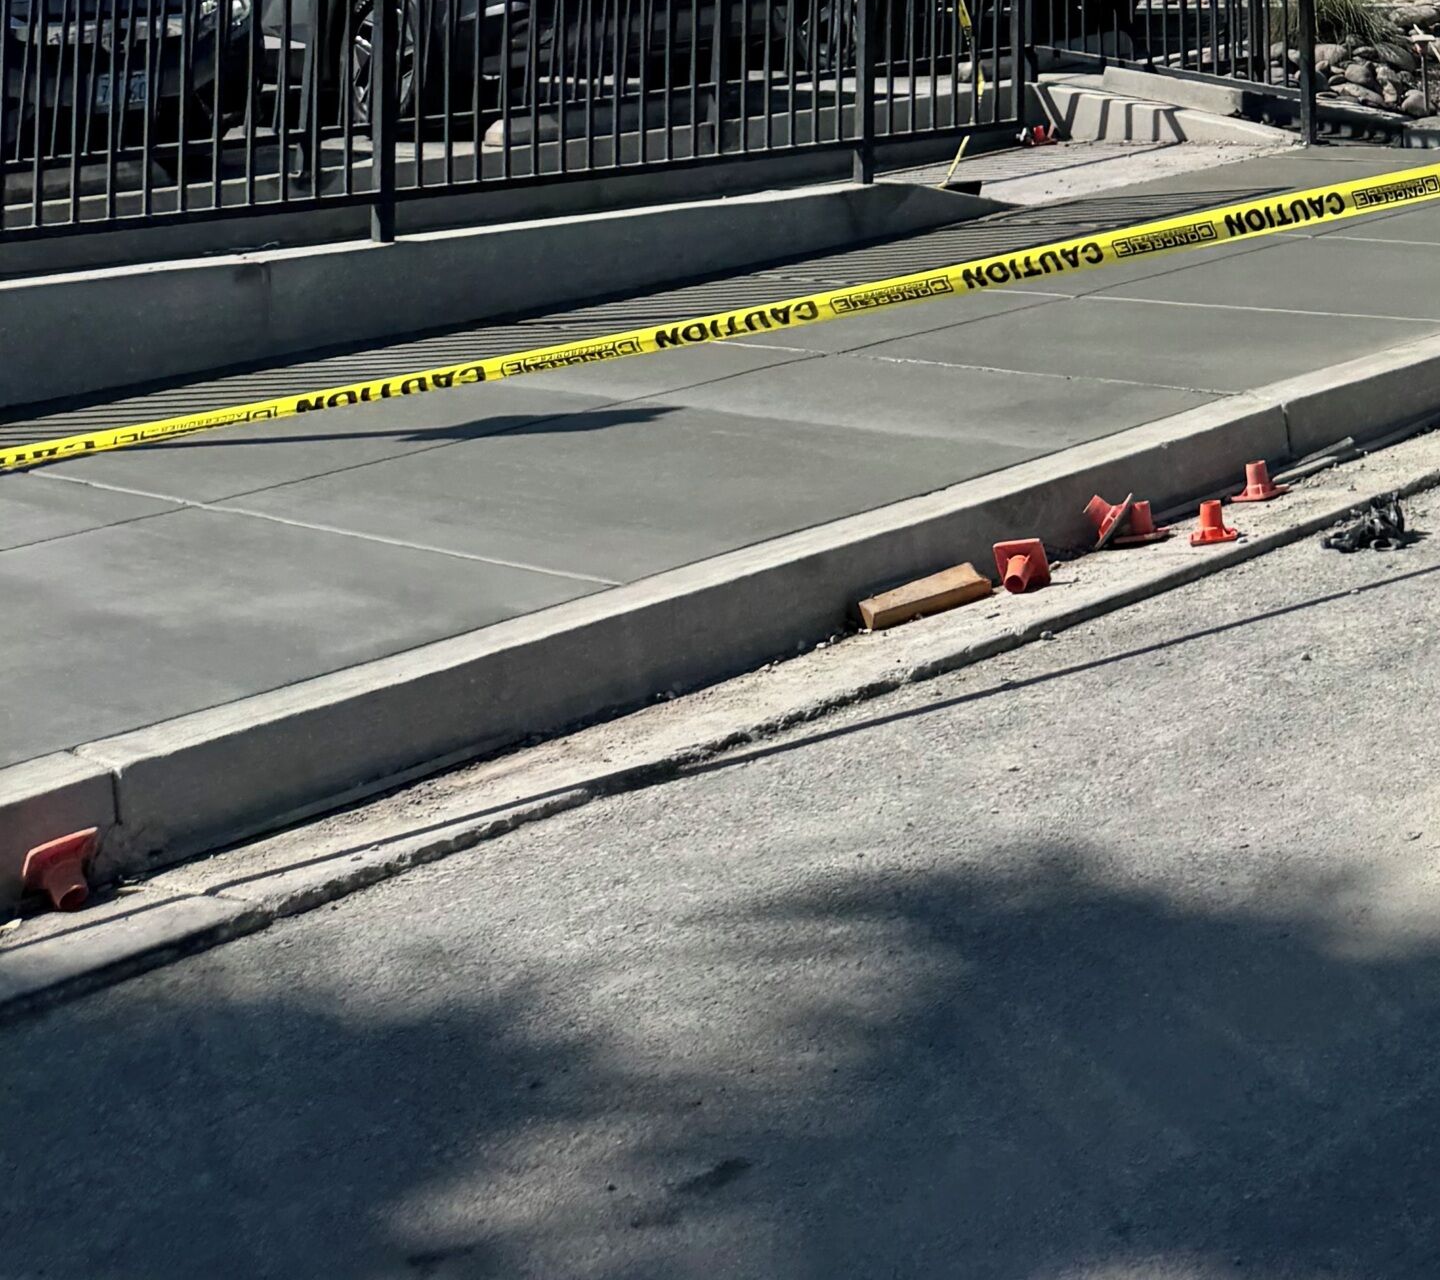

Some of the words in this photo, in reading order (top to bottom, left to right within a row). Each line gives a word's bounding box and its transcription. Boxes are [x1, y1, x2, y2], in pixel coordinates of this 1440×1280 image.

[1224, 191, 1346, 237] CAUTION
[1352, 175, 1440, 210] CONCRETE
[1111, 220, 1218, 258] CONCRETE
[962, 242, 1104, 289] CAUTION
[830, 275, 954, 315] CONCRETE
[655, 300, 820, 349] CAUTION
